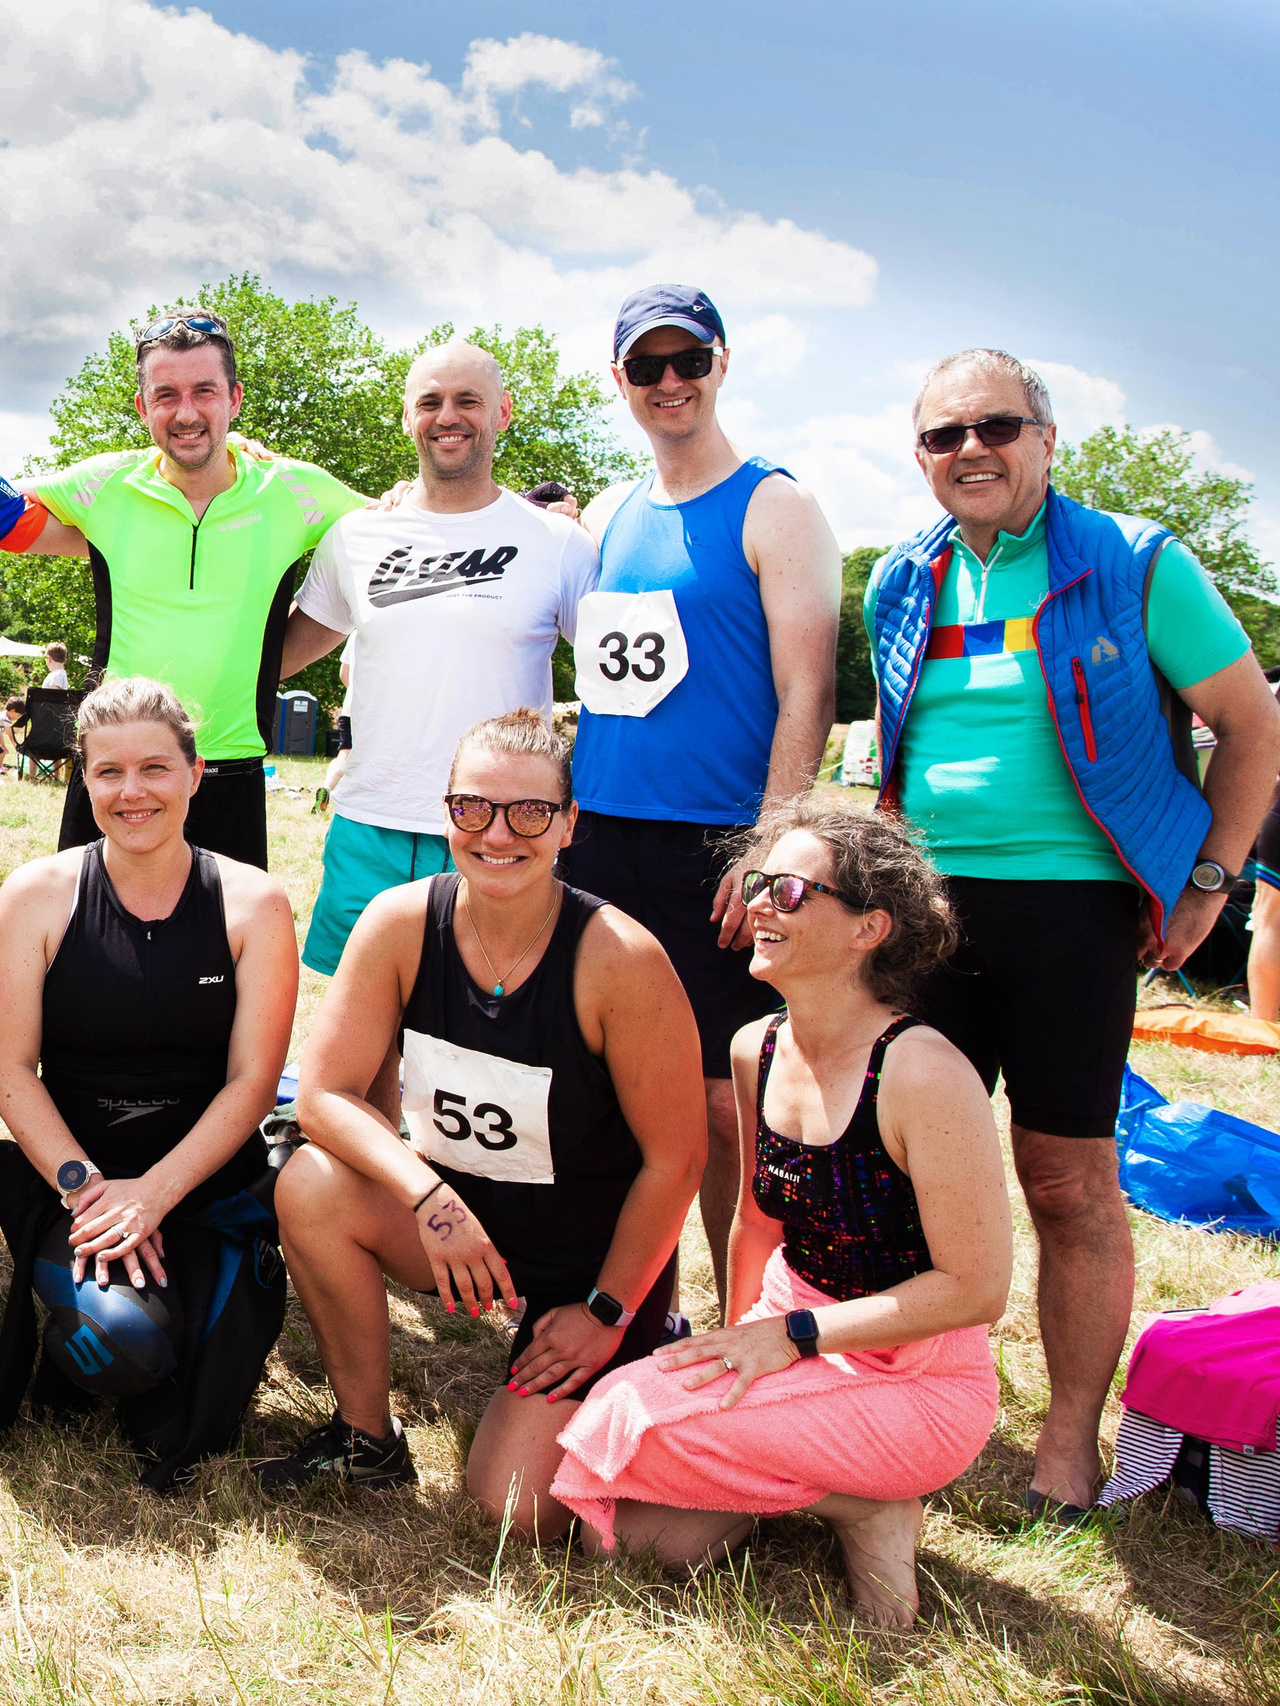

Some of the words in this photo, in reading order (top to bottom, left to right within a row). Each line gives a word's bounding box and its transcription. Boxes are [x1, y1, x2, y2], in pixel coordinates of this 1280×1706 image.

[368, 546, 518, 595] G-STAR
[599, 631, 666, 682] 33
[198, 975, 224, 985] 2XU
[433, 1088, 518, 1151] 53
[768, 1164, 800, 1183] NABAIJI
[427, 1199, 467, 1241] 53
